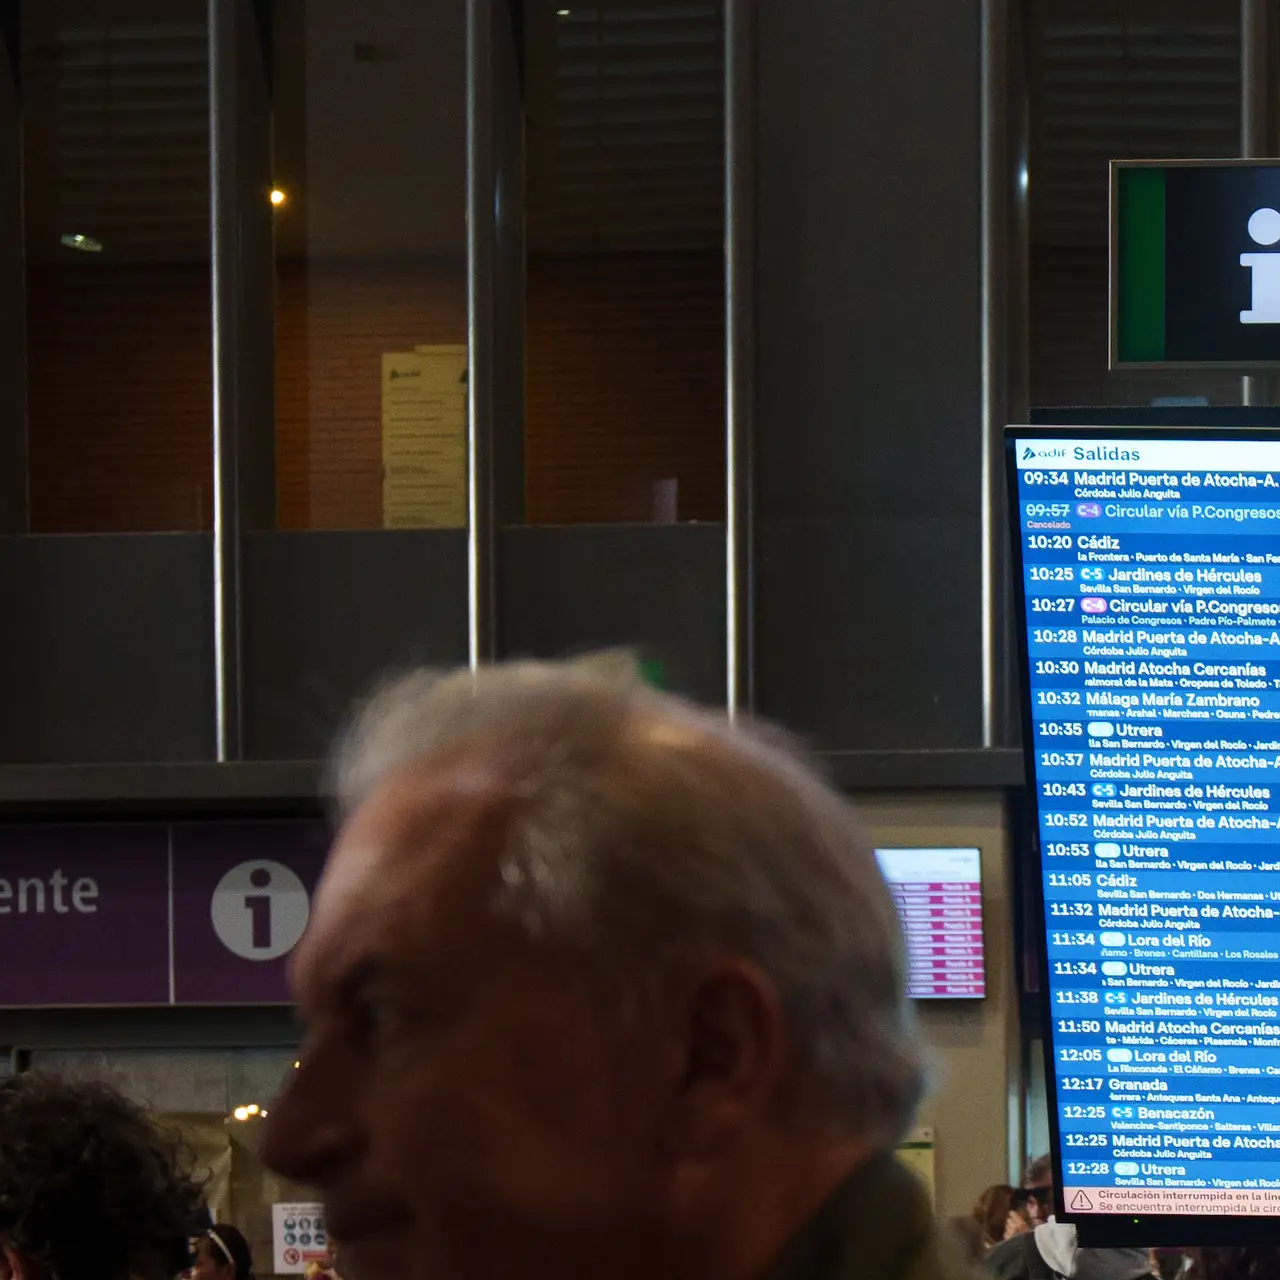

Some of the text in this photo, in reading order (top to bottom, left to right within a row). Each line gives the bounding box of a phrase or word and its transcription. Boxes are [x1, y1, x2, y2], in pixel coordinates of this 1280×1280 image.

[1073, 446, 1140, 460] Salidas
[1023, 471, 1068, 484] 09:34
[1074, 471, 1126, 485] Madrid
[1129, 472, 1178, 486] Puerta
[1181, 472, 1201, 486] de
[1203, 472, 1279, 487] Atocha-A.
[1105, 504, 1164, 517] Circular
[1166, 504, 1188, 518] vía
[1028, 535, 1072, 548] 10:20
[1077, 534, 1120, 549] Cádiz
[1030, 567, 1074, 580] 10:25
[1107, 567, 1262, 582] Jardines de Hércules
[1032, 598, 1075, 611] 10:27
[1109, 598, 1168, 613] Circular
[1170, 599, 1193, 613] vía
[1034, 629, 1077, 642] 10:28
[1082, 629, 1134, 643] Madrid
[1136, 630, 1185, 644] Puerta
[1187, 630, 1207, 644] de
[1035, 660, 1079, 674] 10:30
[1084, 661, 1266, 676] Madrid Atocha Cercanías
[1037, 691, 1080, 704] 10:32
[1086, 691, 1260, 708] Málaga María Zambrano
[1039, 722, 1082, 735] 10:35
[1116, 723, 1163, 736] Utrera
[1052, 932, 1095, 945] 11:34
[1127, 933, 1211, 947] Lora del Río
[1058, 1020, 1100, 1032] 11:50
[1105, 1020, 1280, 1035] Madrid Atocha Cercanías
[1062, 1077, 1103, 1090] 12:17
[1108, 1078, 1168, 1091] Granada
[1064, 1106, 1105, 1118] 12:25
[1137, 1106, 1214, 1119] Benacazón
[1098, 1189, 1160, 1199] Circulación
[1162, 1191, 1232, 1201] interrumpida
[1235, 1193, 1248, 1201] en
[1251, 1191, 1261, 1201] la
